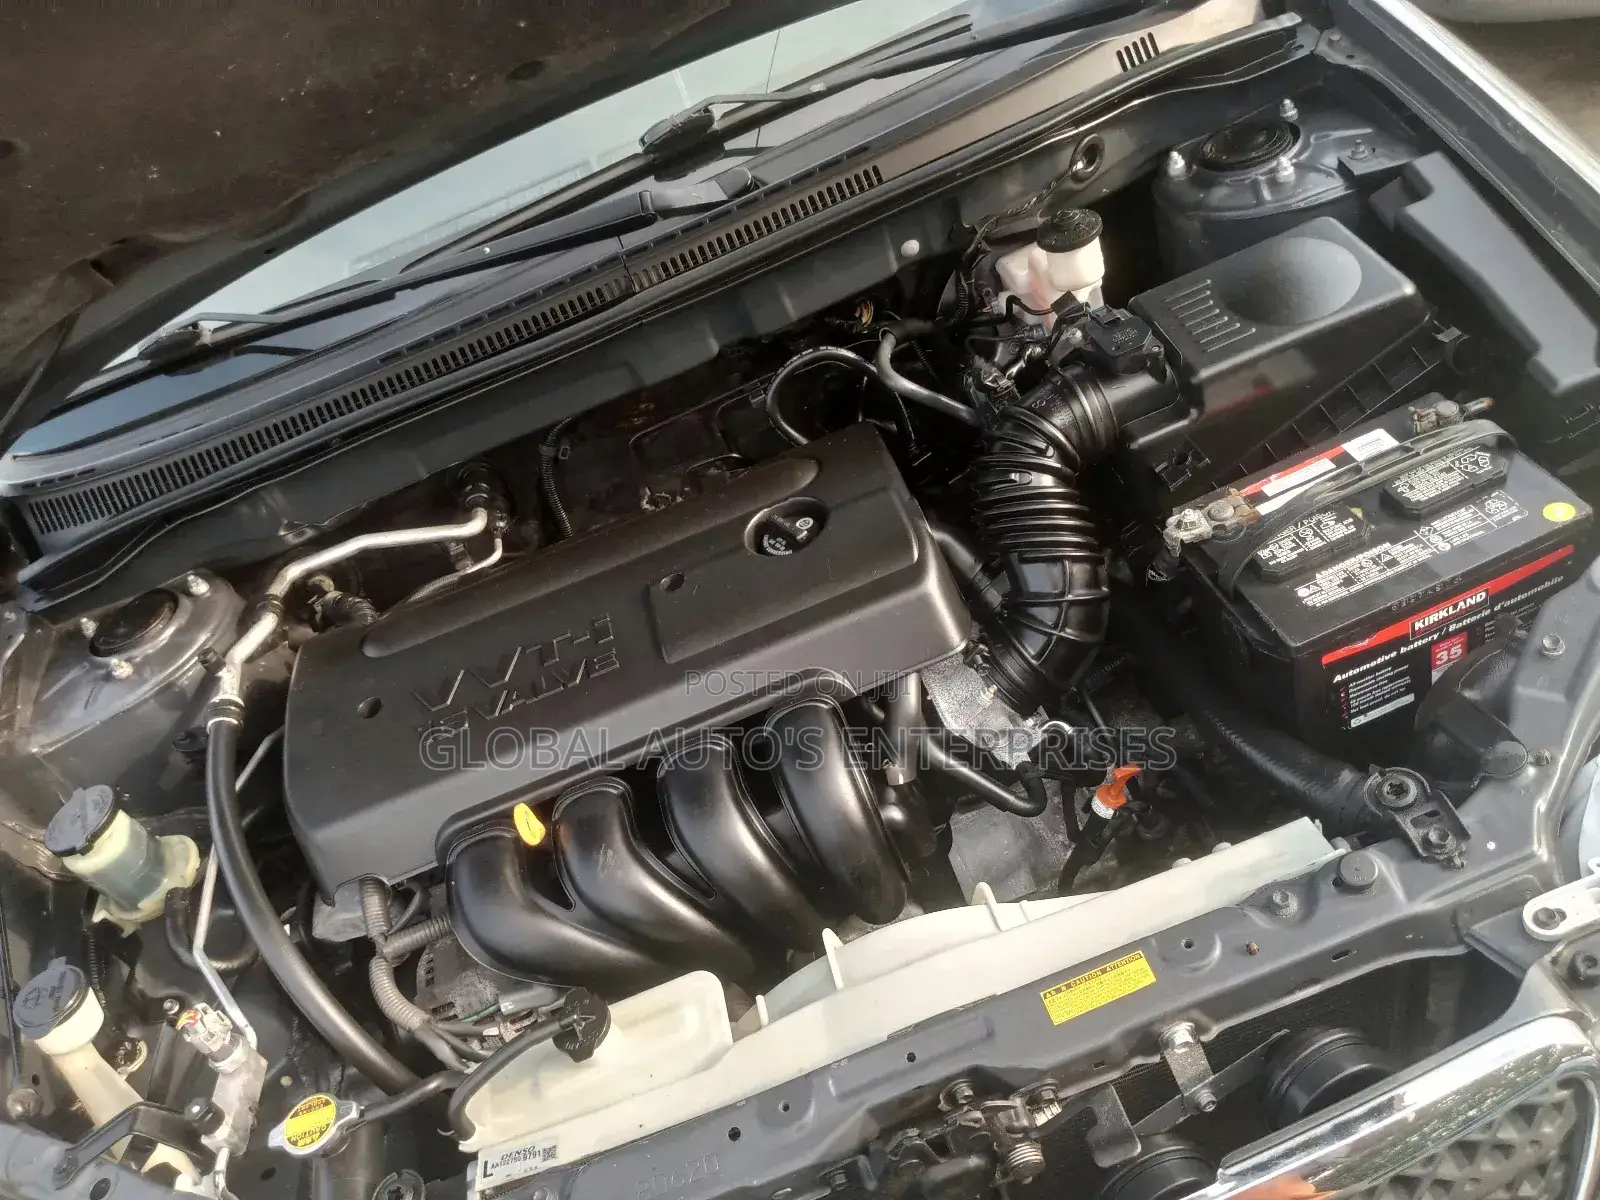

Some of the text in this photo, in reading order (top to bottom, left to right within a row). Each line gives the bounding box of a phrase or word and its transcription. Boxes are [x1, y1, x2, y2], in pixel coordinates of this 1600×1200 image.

[1413, 591, 1487, 631] KIRKLAND
[1333, 649, 1397, 683] Automotive
[1400, 632, 1440, 655] battery
[1448, 608, 1493, 632] Batterie
[1493, 574, 1565, 612] d'automobile
[1436, 646, 1463, 666] 35
[501, 1145, 535, 1160] DENSO
[483, 1160, 493, 1178] L
